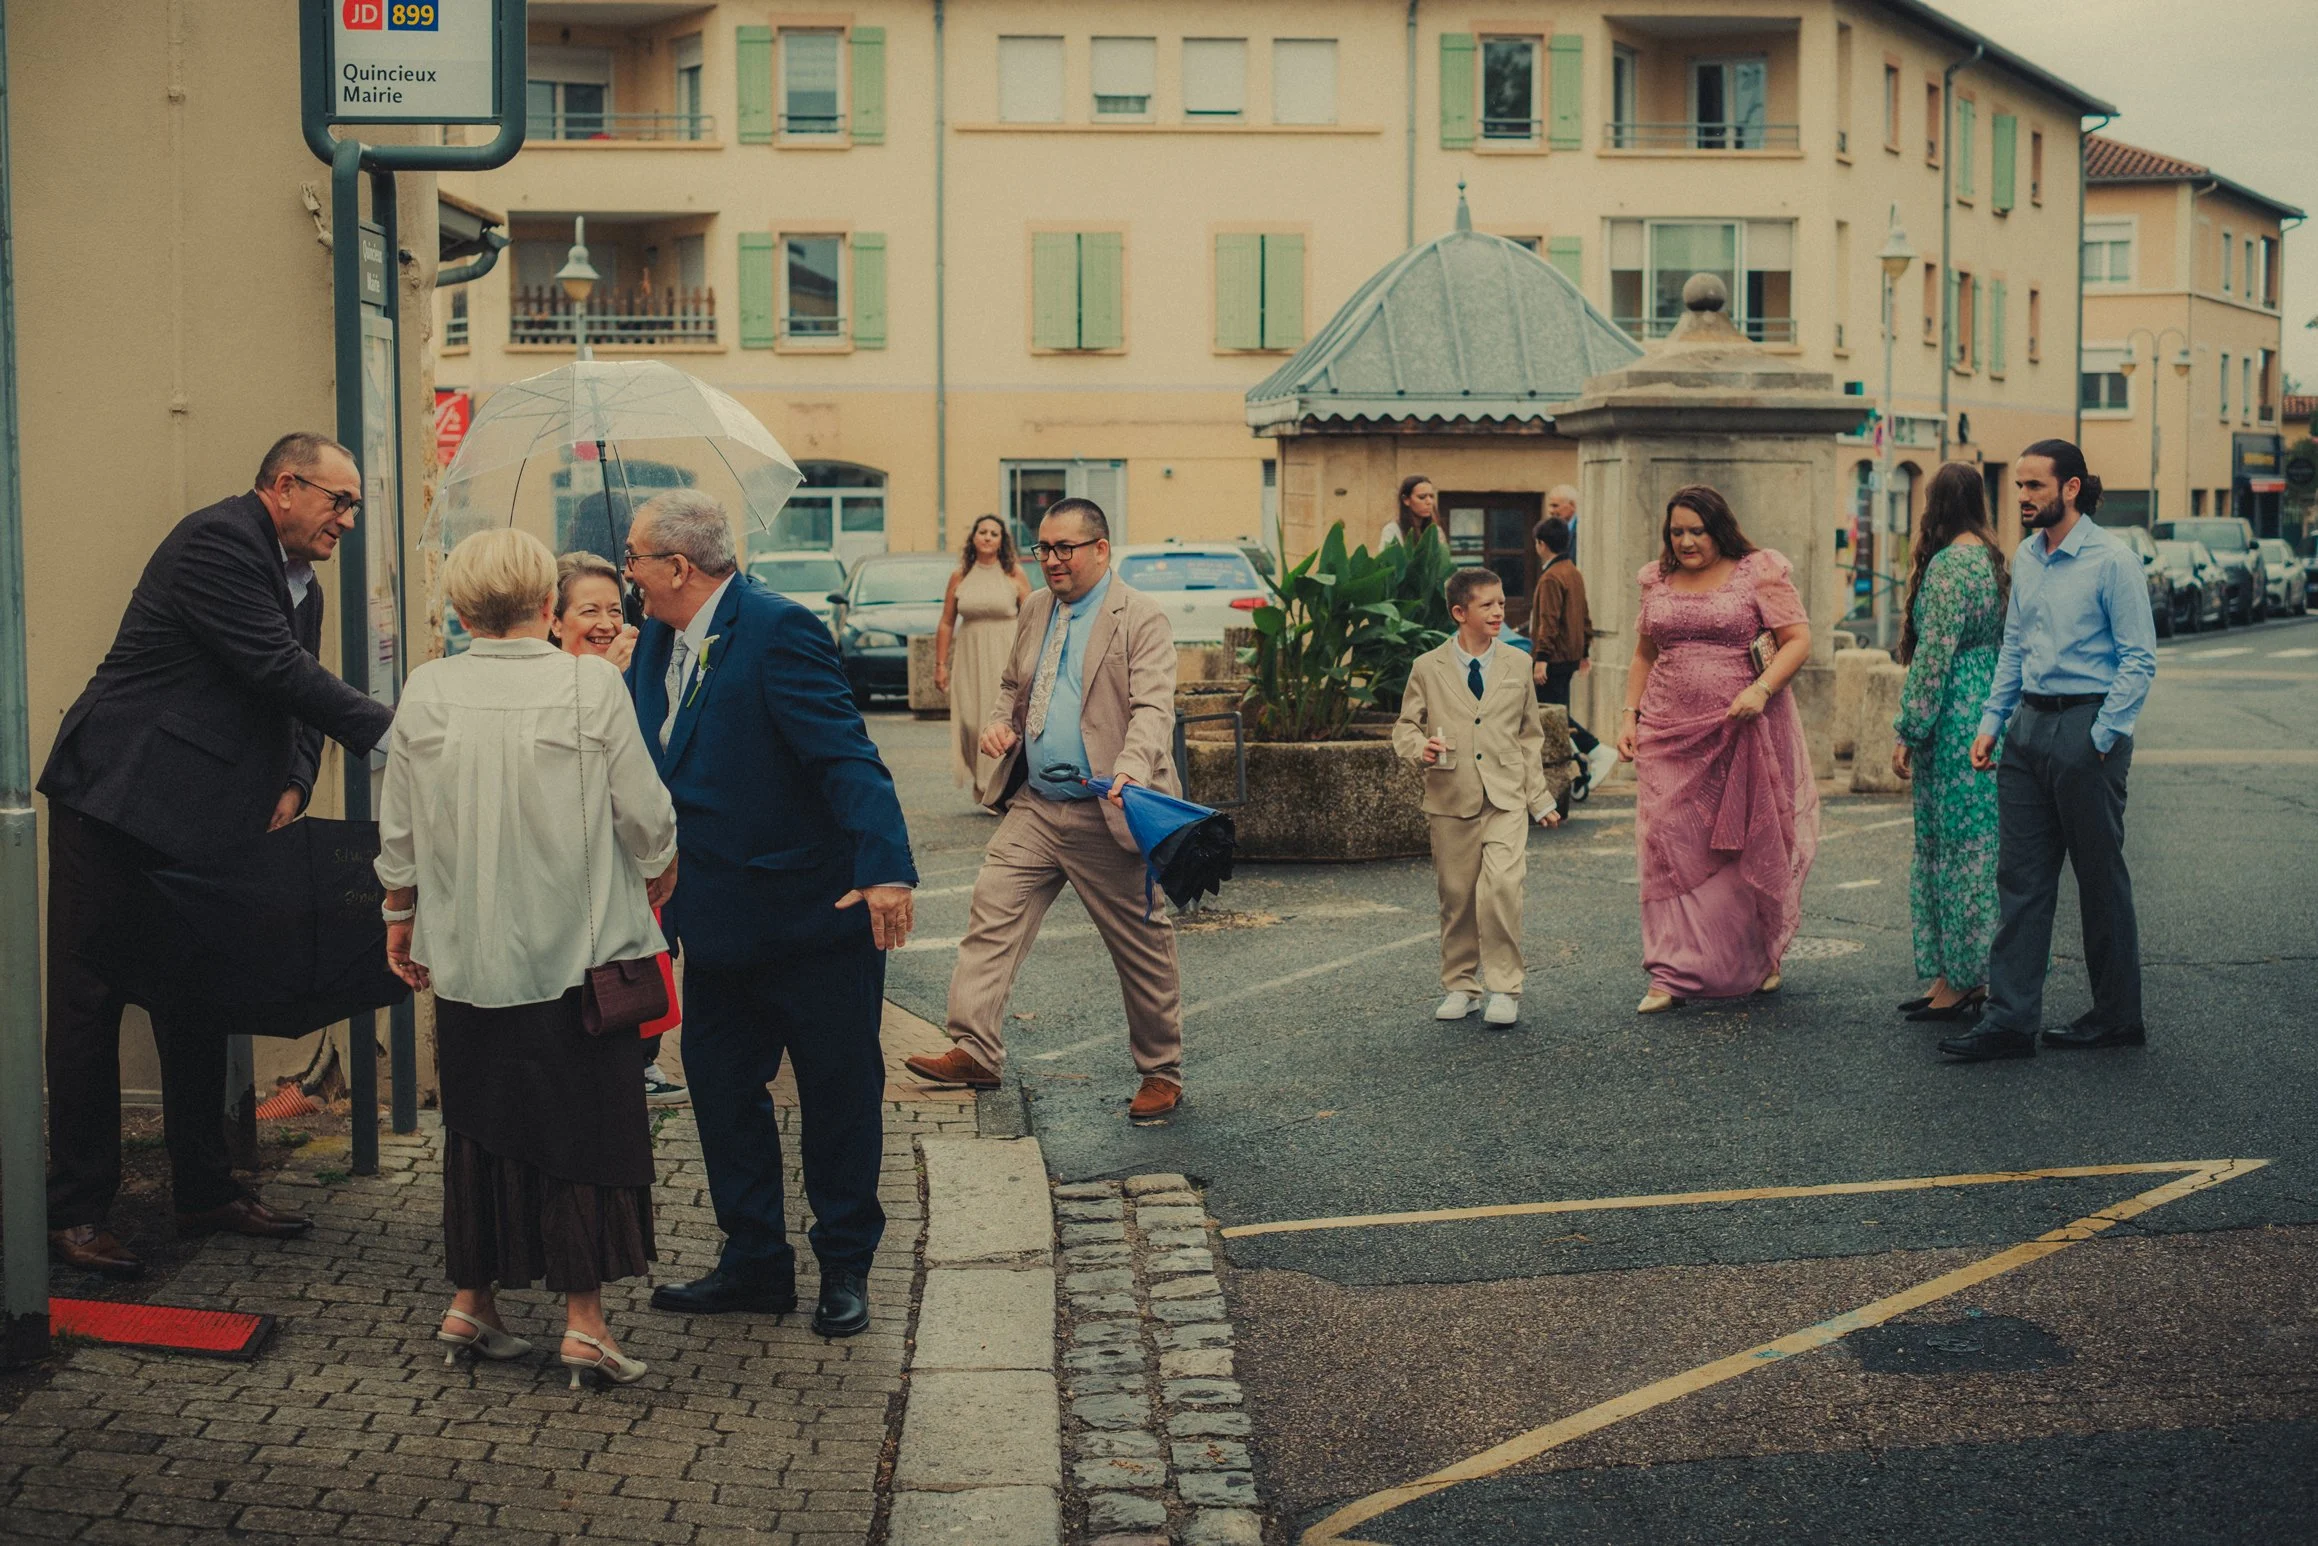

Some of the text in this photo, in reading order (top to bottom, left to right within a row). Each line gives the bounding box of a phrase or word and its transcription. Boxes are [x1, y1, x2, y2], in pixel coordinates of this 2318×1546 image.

[351, 3, 435, 26] JD 899
[343, 63, 437, 84] Quincieux
[343, 85, 403, 104] Mairie
